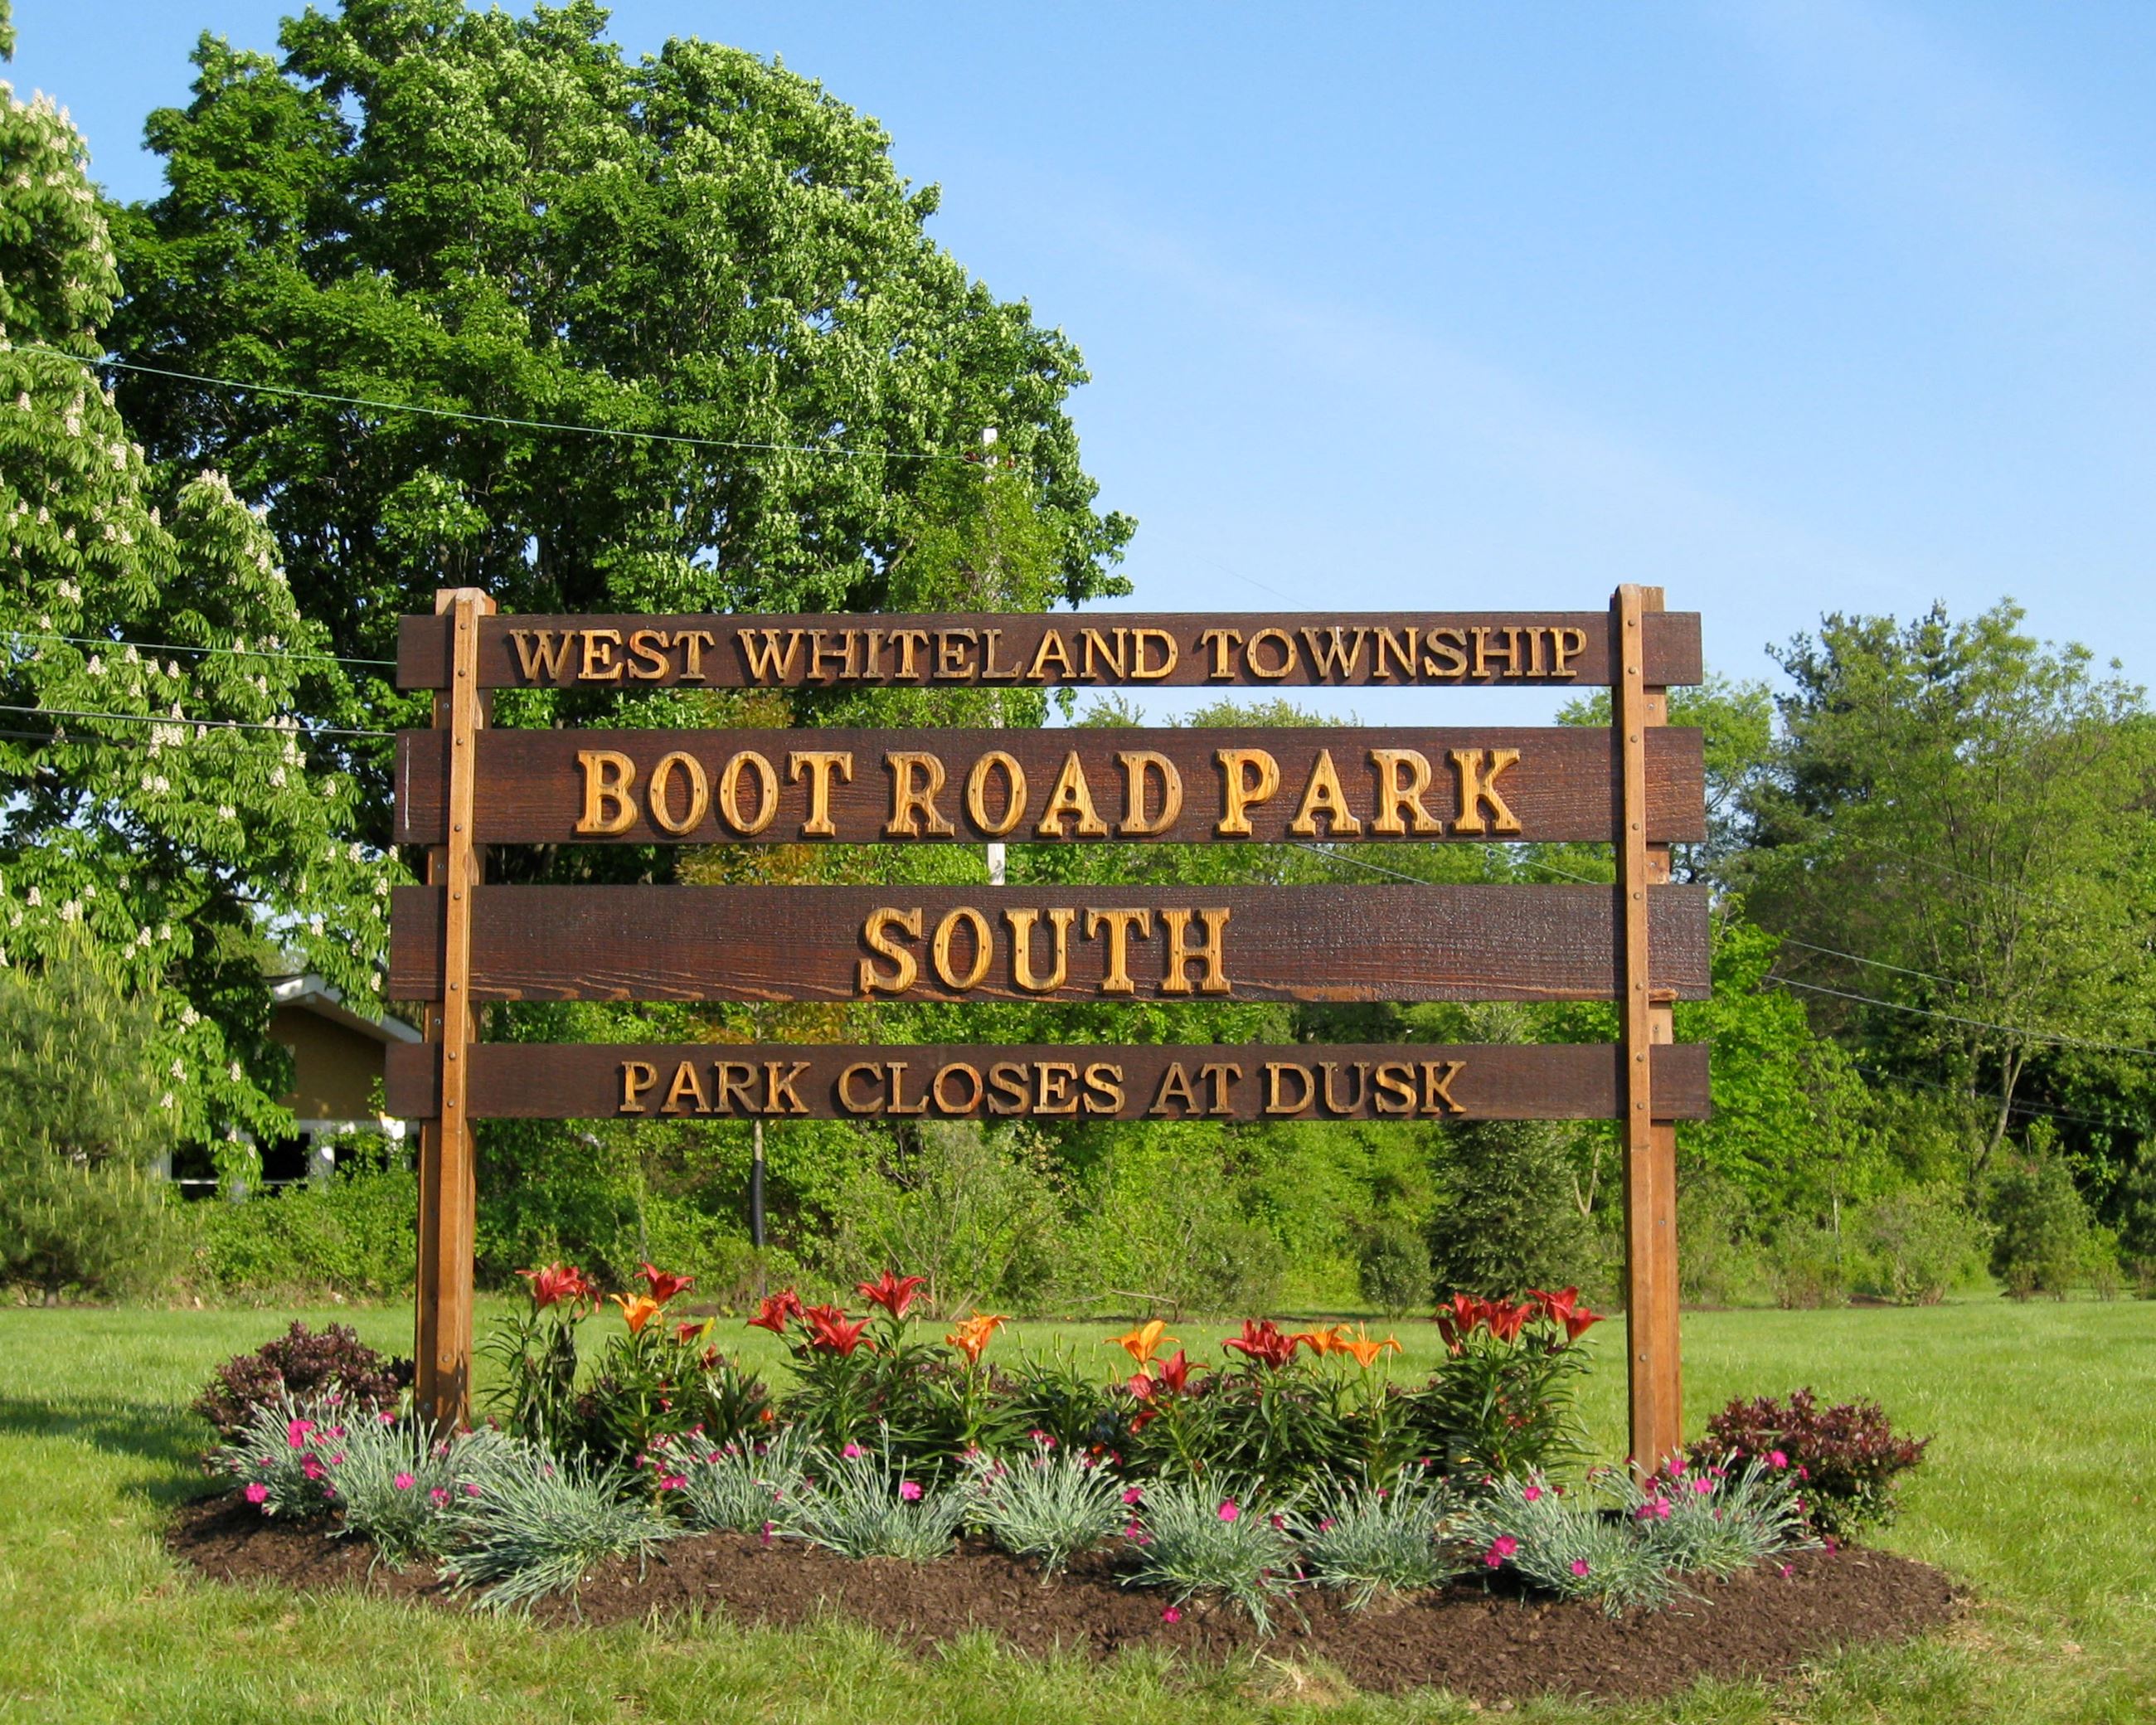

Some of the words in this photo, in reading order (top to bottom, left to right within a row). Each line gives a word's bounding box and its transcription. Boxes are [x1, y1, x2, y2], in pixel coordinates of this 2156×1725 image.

[508, 628, 716, 681] WEST
[736, 628, 1179, 681] WHITELAND
[1201, 625, 1589, 678] TOWNSHIP
[575, 749, 853, 837] BOOT
[884, 749, 1184, 838] ROAD
[1216, 747, 1523, 836] PARK
[857, 906, 1232, 995] SOUTH
[619, 1060, 812, 1115] PARK
[838, 1061, 1126, 1115] CLOSES
[1150, 1061, 1242, 1115] AT
[1265, 1060, 1468, 1115] DUSK
